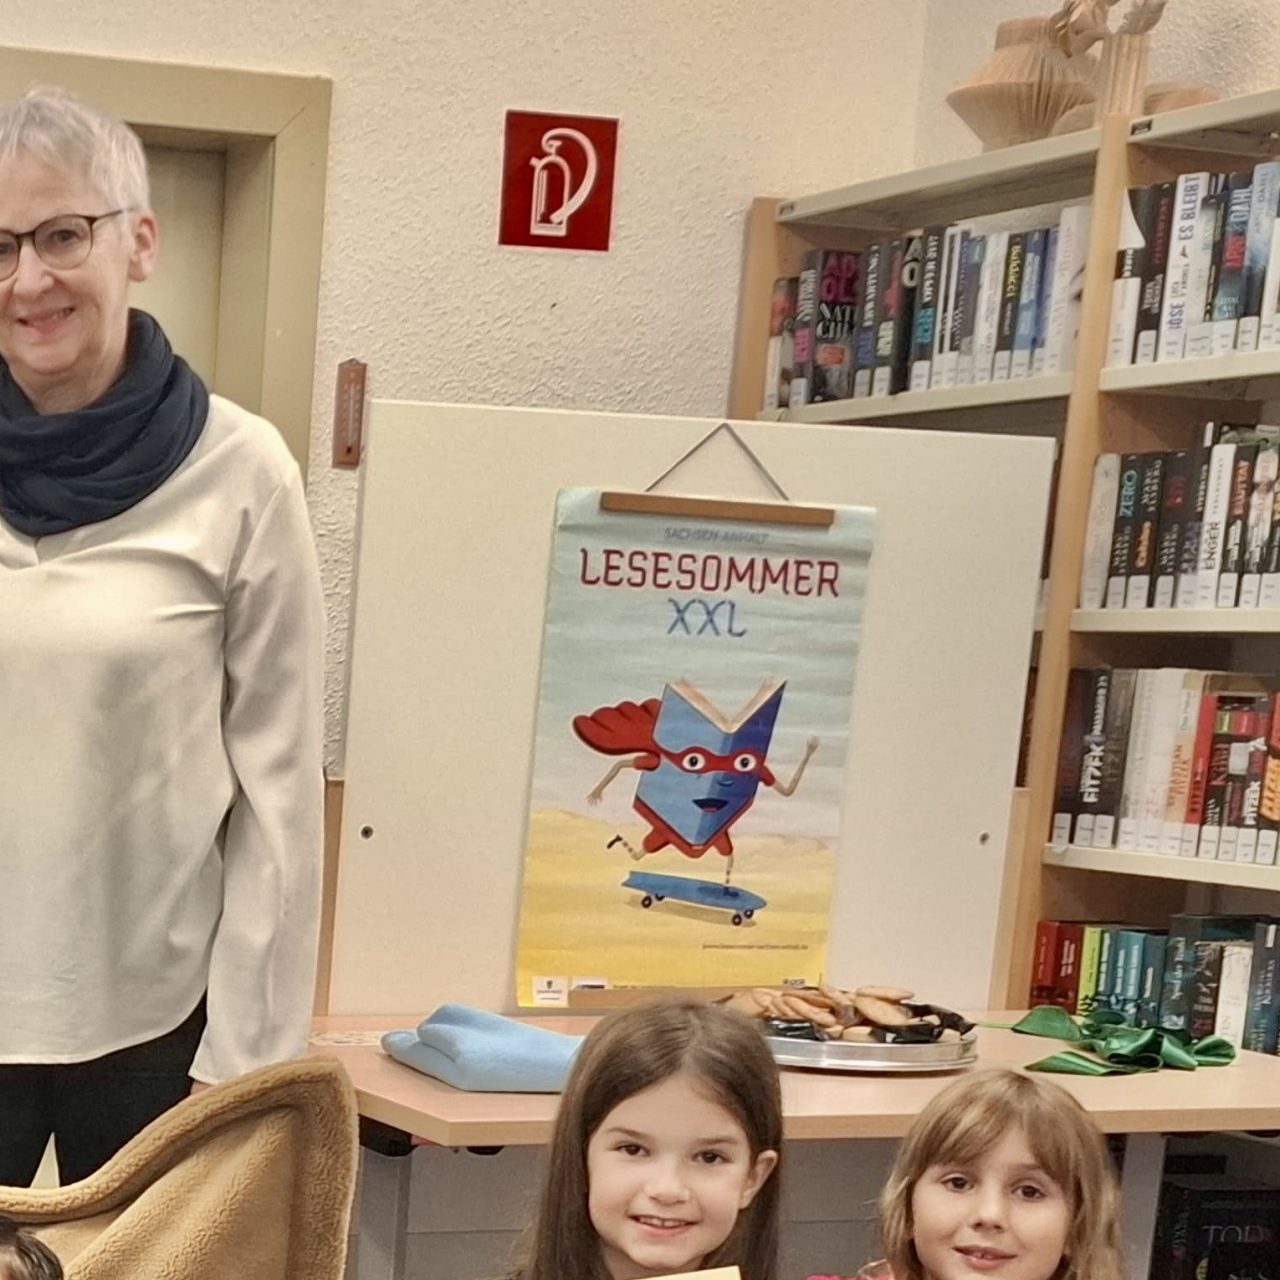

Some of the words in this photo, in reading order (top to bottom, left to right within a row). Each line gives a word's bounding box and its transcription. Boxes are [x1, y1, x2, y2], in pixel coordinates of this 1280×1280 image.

[1120, 469, 1138, 518] ZERO
[663, 527, 769, 545] SACHSEN-ANHALT
[580, 547, 840, 598] LESESOMMER
[667, 597, 748, 638] XXL
